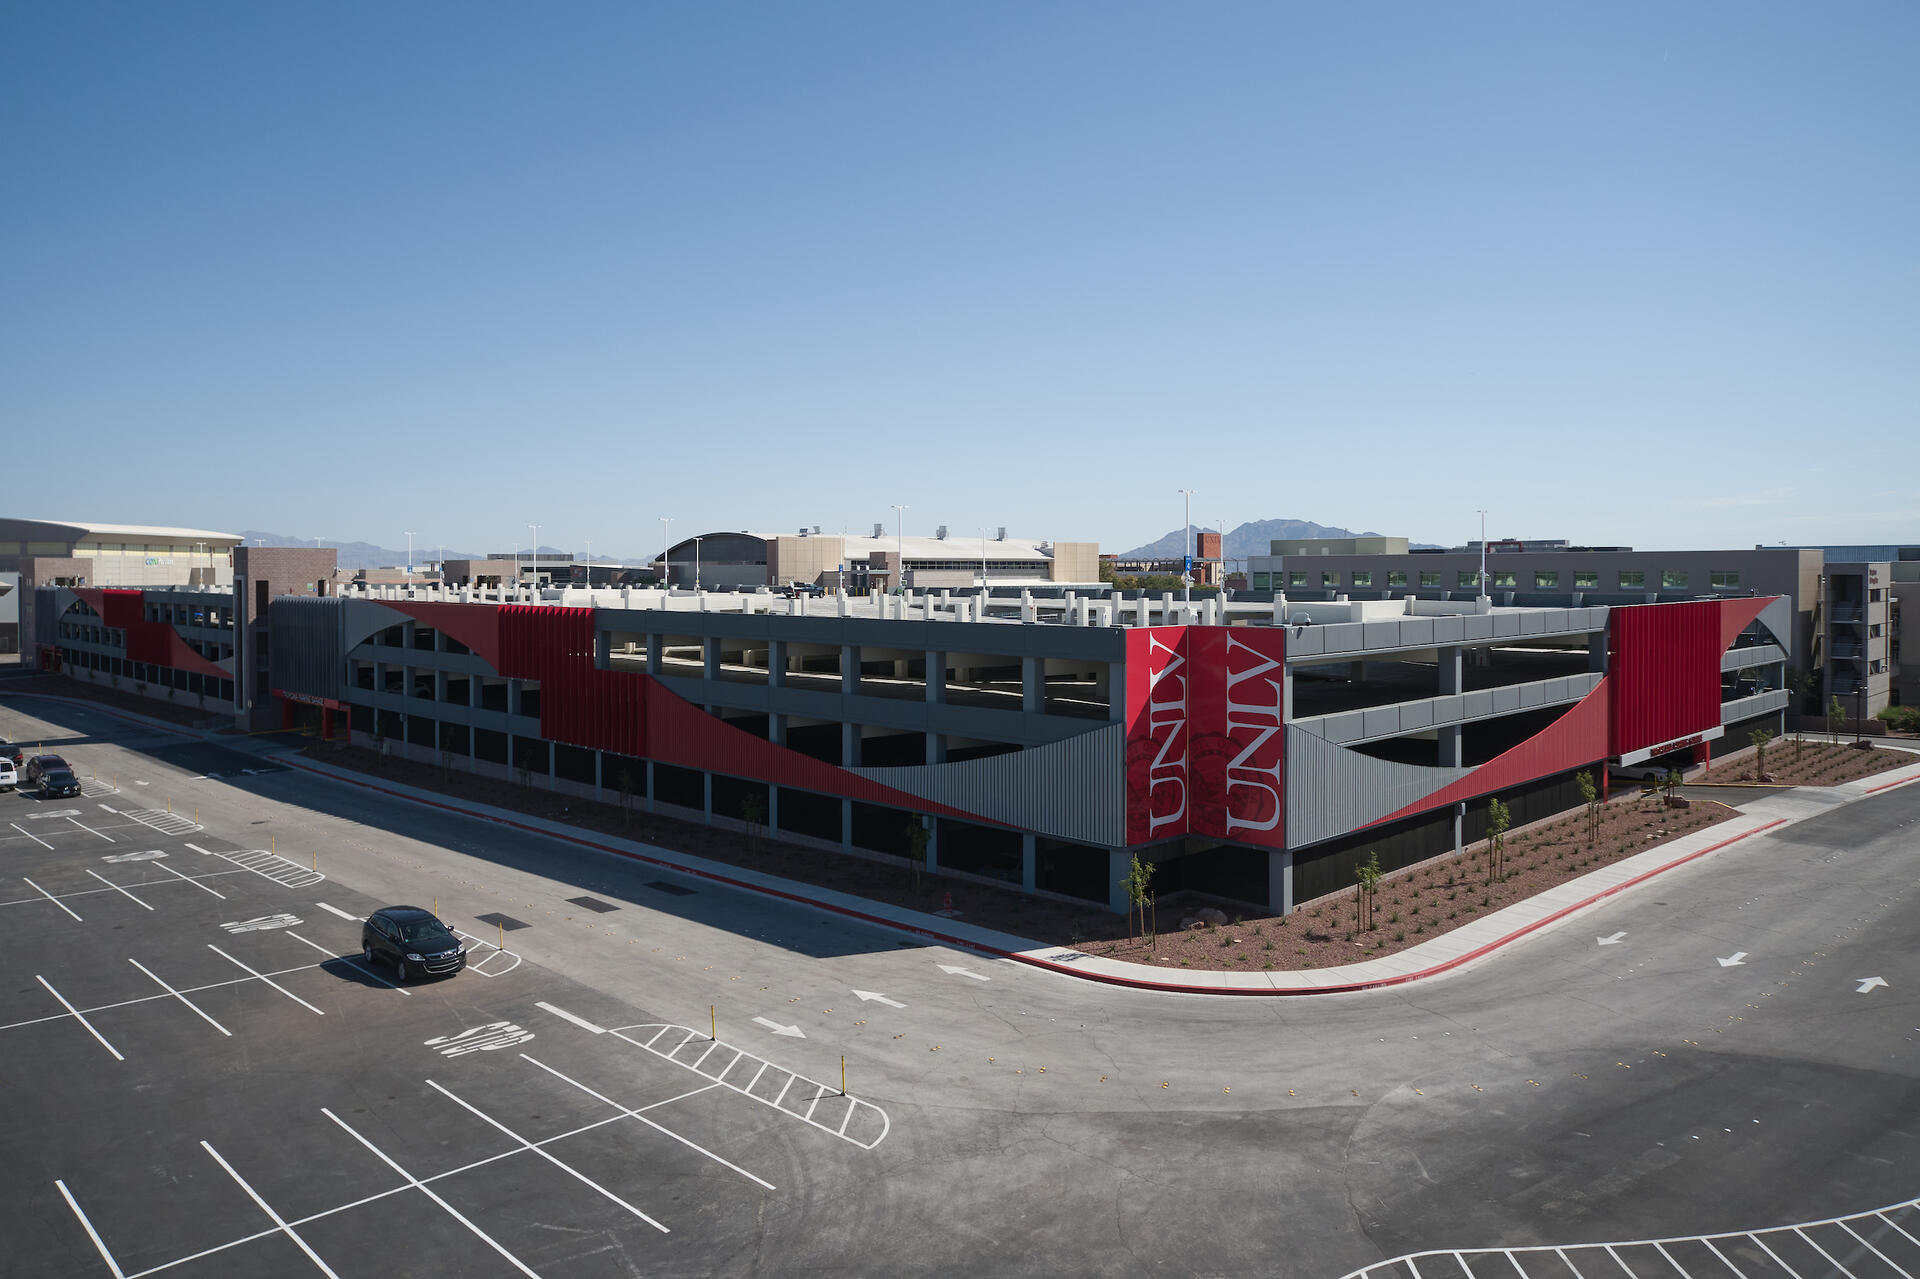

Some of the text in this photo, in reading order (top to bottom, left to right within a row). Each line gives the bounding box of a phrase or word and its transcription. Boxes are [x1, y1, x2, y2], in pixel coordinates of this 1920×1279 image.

[1149, 631, 1186, 837] UNLV
[1227, 631, 1281, 835] UNLV
[423, 1021, 536, 1058] STOP
